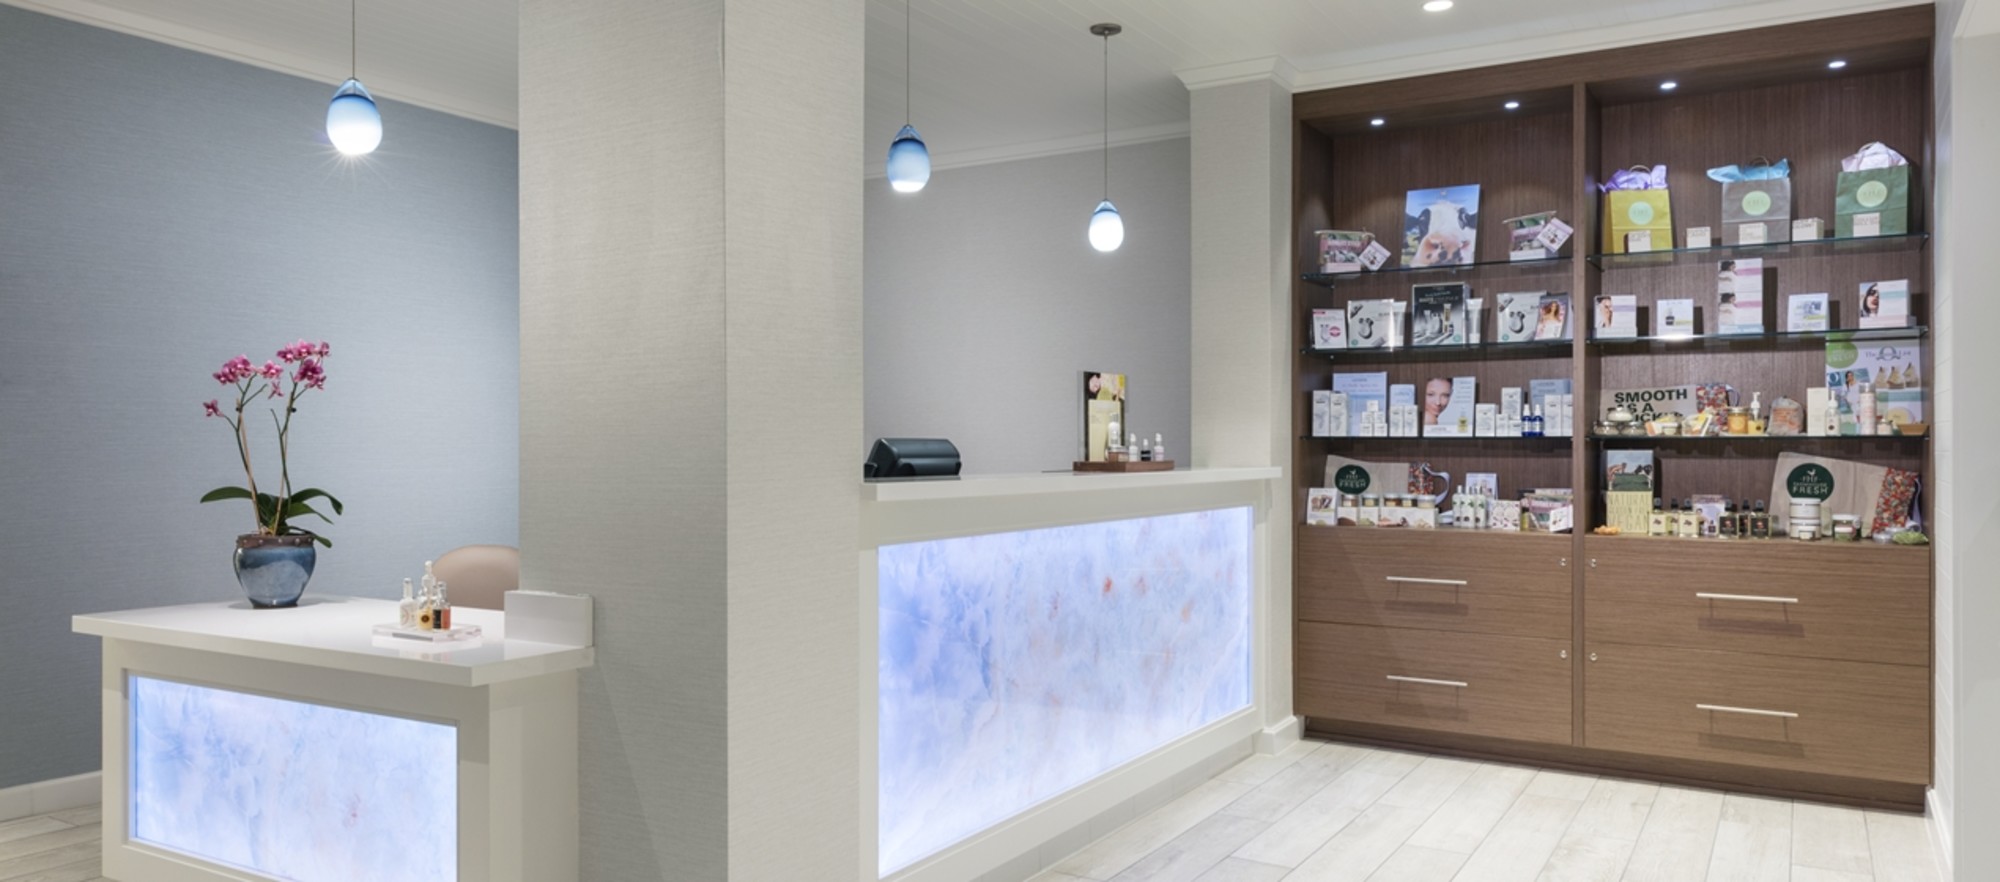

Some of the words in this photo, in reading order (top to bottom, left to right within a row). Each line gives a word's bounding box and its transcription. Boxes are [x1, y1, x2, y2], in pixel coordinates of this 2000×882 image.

[1614, 388, 1687, 403] SMOOTH
[1617, 402, 1637, 413] S
[1642, 402, 1654, 413] A
[1793, 485, 1829, 495] FRESH
